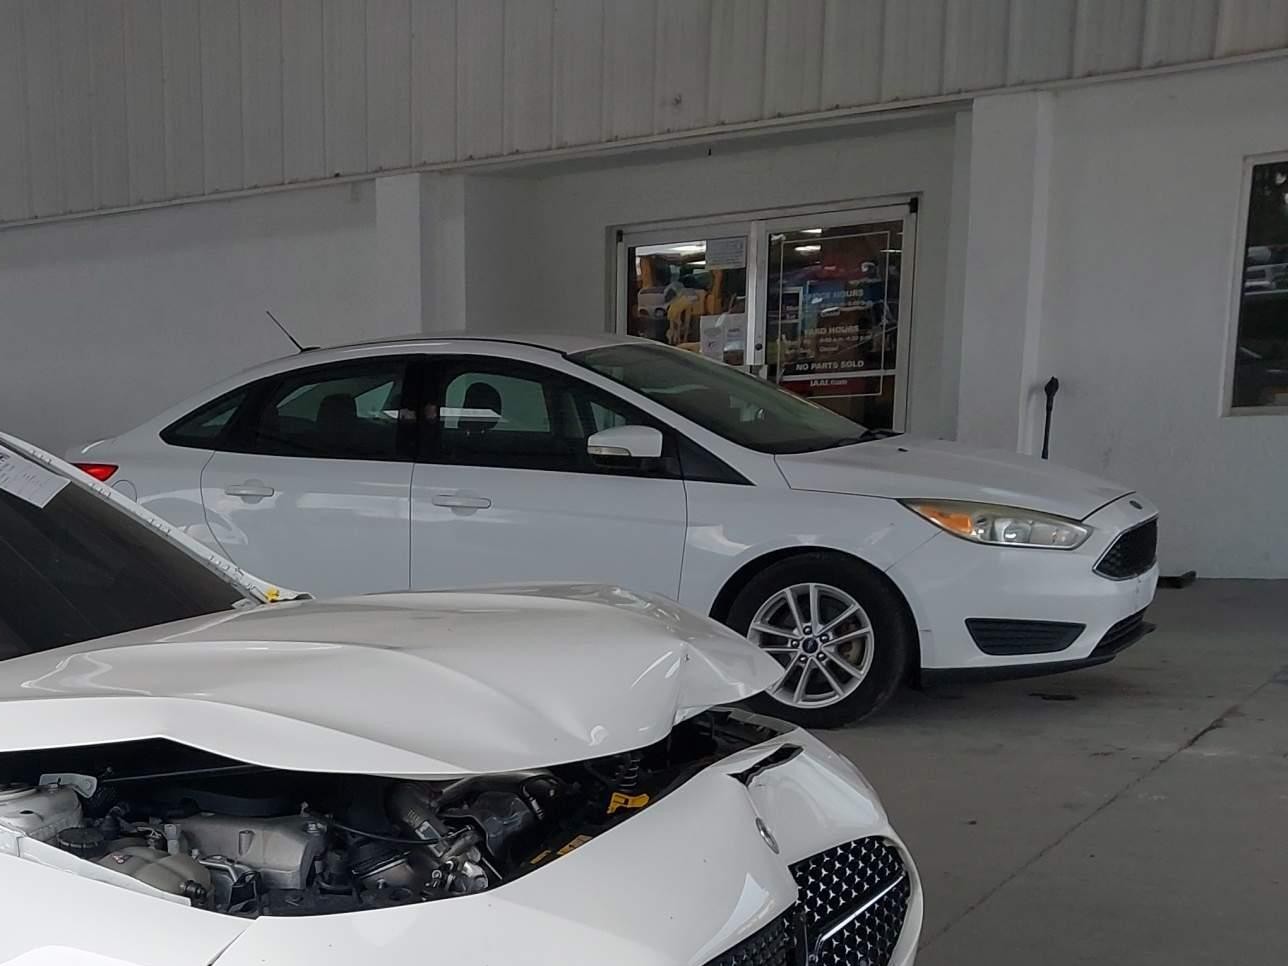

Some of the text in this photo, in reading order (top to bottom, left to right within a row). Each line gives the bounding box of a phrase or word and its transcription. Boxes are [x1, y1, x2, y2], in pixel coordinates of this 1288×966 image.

[795, 360, 865, 371] NO PARTS SOLD
